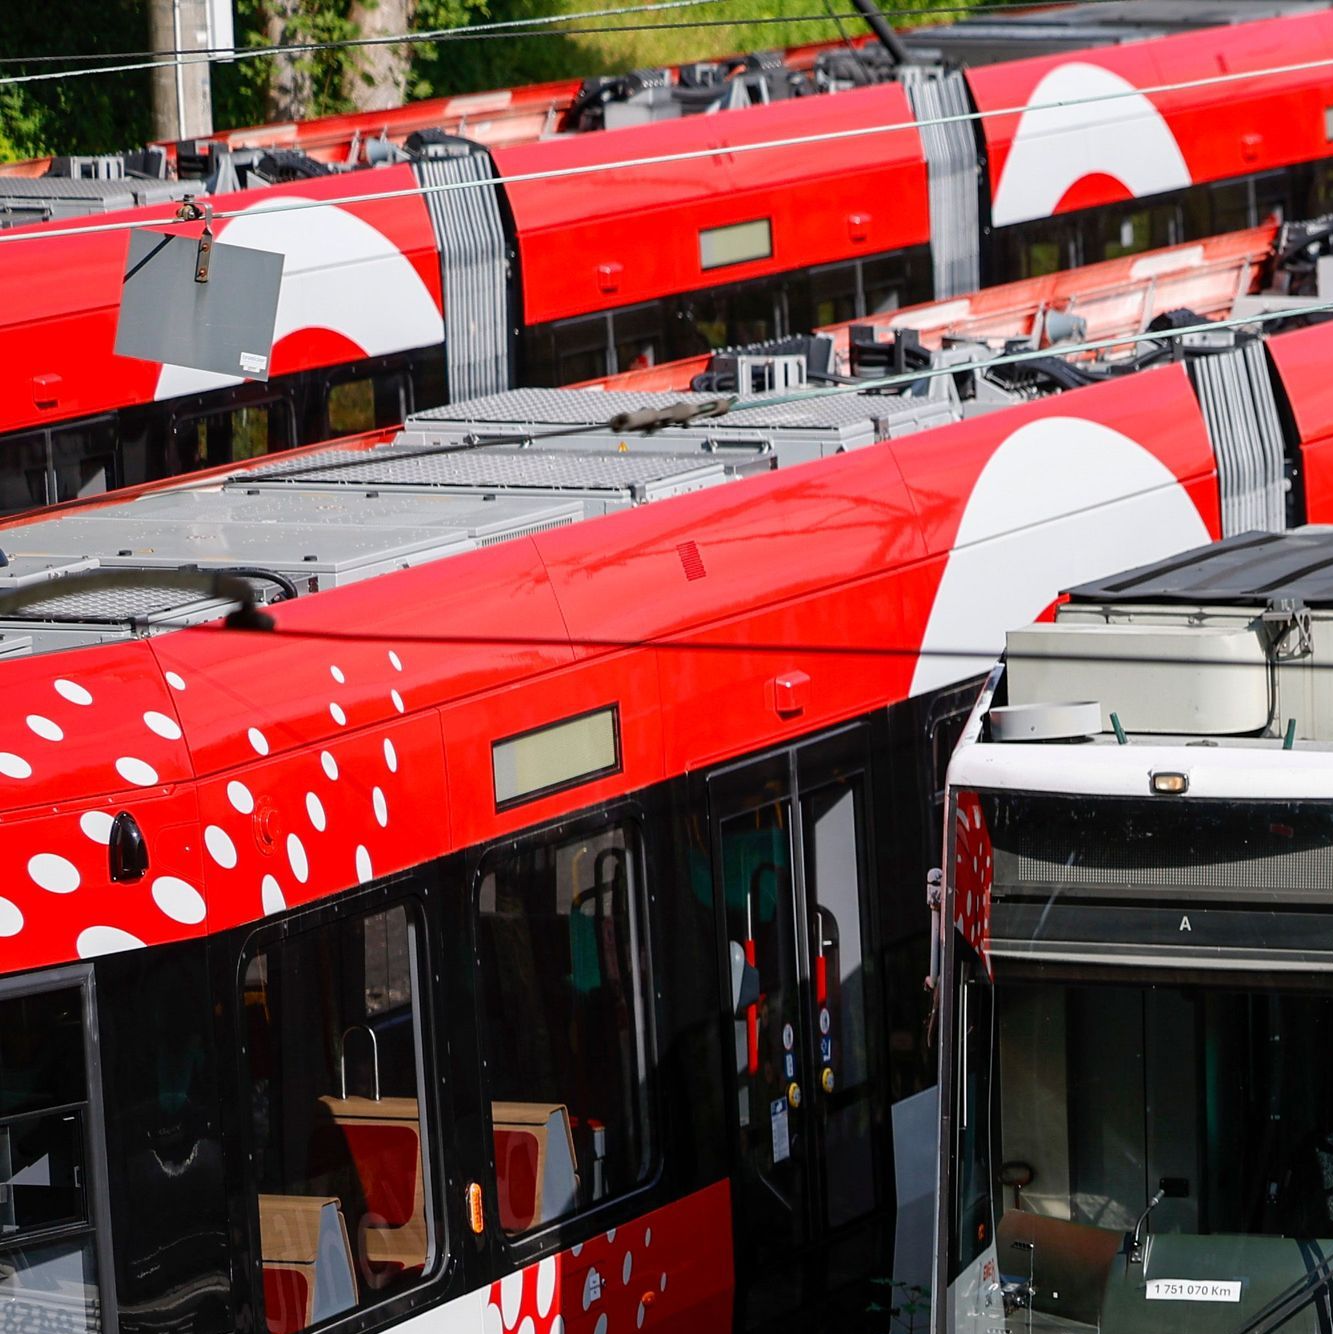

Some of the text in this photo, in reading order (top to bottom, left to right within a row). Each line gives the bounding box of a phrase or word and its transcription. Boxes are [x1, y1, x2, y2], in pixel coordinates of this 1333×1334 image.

[1179, 915, 1191, 931] A
[1154, 1284, 1231, 1296] 1 751 070 Km
